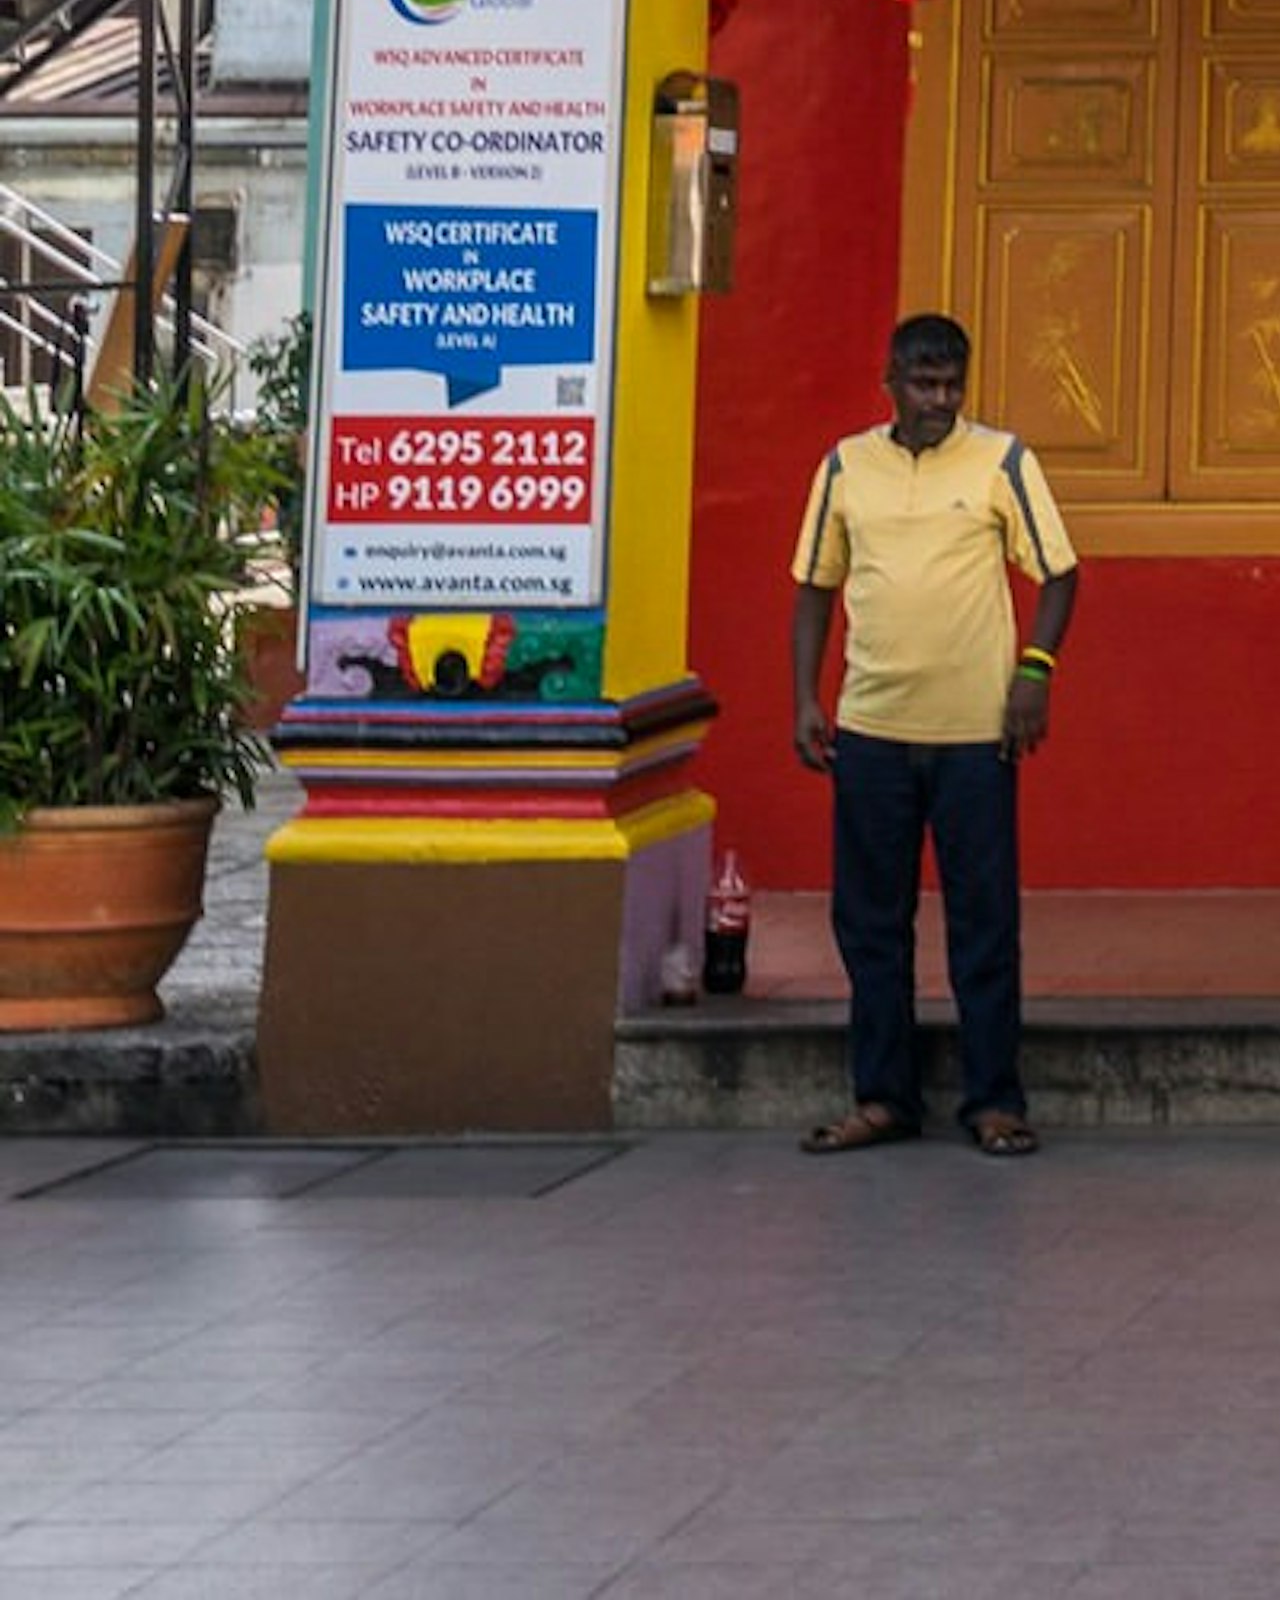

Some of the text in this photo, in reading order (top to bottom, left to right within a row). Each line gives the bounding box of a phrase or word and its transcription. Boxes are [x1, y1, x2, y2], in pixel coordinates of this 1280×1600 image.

[373, 49, 585, 67] WSQ ADVANCED CERTIFICATE
[350, 100, 606, 117] WORKPLACE SAFETY AND HEALTH
[346, 130, 605, 153] SAFETY CO-ORDINATOR
[383, 221, 559, 248] WSQ CERTIFICATE
[462, 249, 479, 265] IN
[402, 267, 537, 293] WORKPLACE
[360, 302, 575, 327] SAFETY AND HEALTH
[336, 429, 587, 466] Tel 6295 2112
[334, 474, 586, 511] HP 9119 6999
[364, 541, 567, 562] enquiry@avanta.com.sg
[358, 574, 573, 595] www.avanta.com.sg
